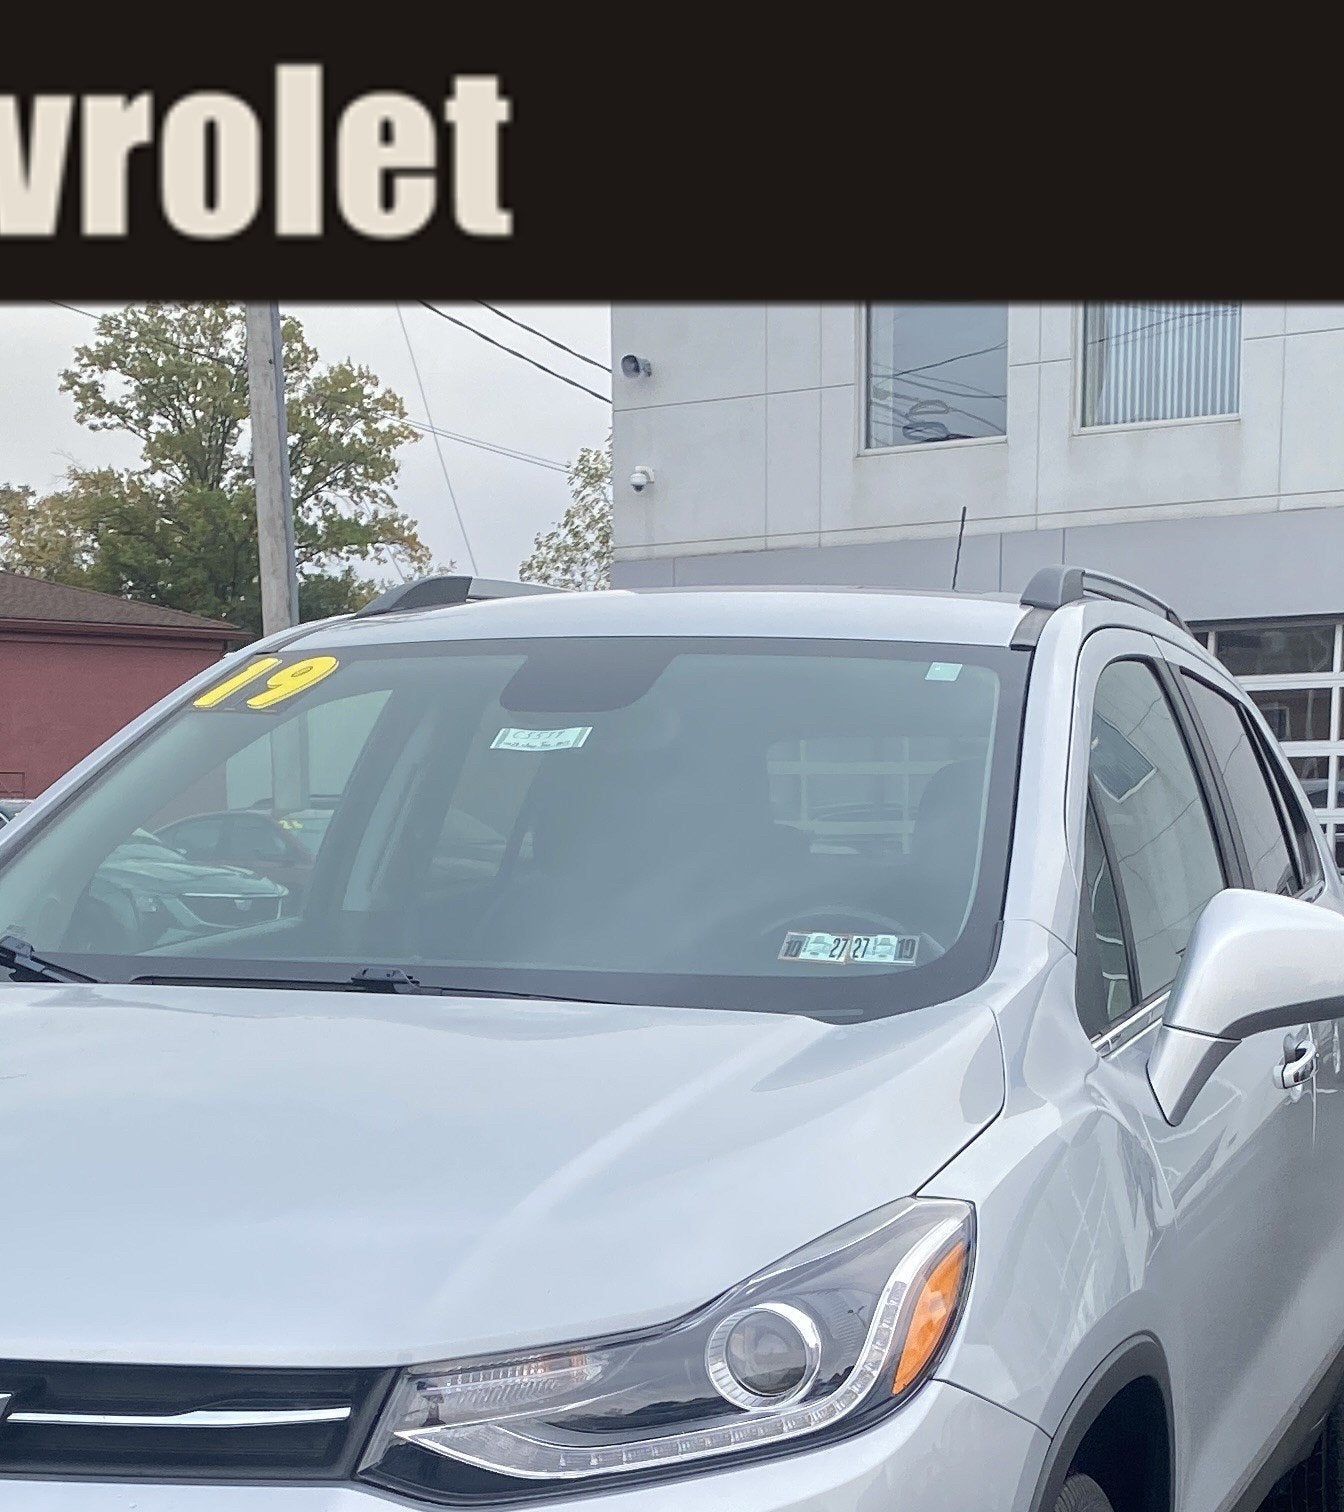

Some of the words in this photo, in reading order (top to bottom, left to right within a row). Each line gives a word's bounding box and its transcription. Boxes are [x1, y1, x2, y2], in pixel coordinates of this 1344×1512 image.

[193, 656, 340, 709] 19
[829, 937, 849, 960] 27
[851, 937, 871, 959] 27
